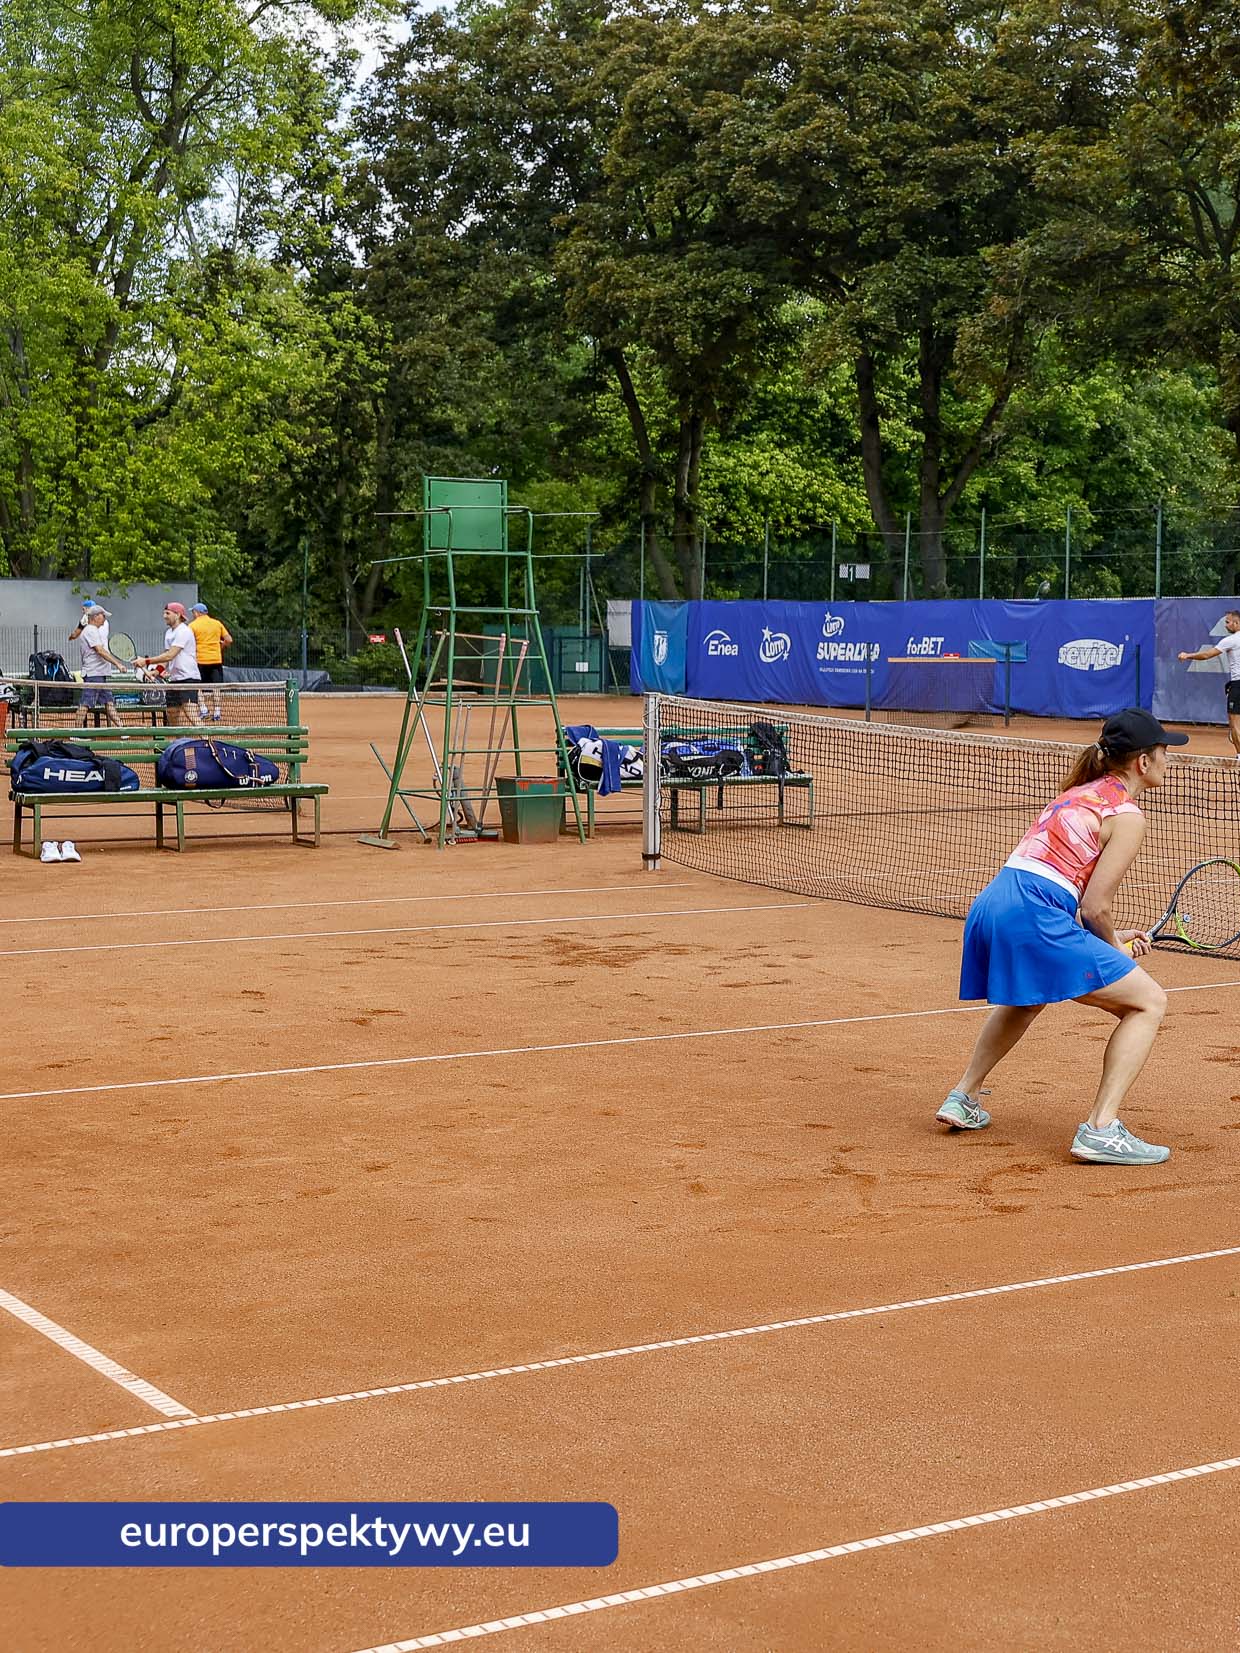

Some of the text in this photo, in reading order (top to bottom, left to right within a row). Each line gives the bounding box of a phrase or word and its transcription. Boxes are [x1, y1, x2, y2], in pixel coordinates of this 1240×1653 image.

[849, 566, 854, 583] 1
[708, 640, 738, 656] Enea
[765, 638, 785, 657] LOTTO
[906, 636, 945, 655] forBET
[1058, 644, 1124, 666] sevitel
[43, 767, 106, 783] HEA
